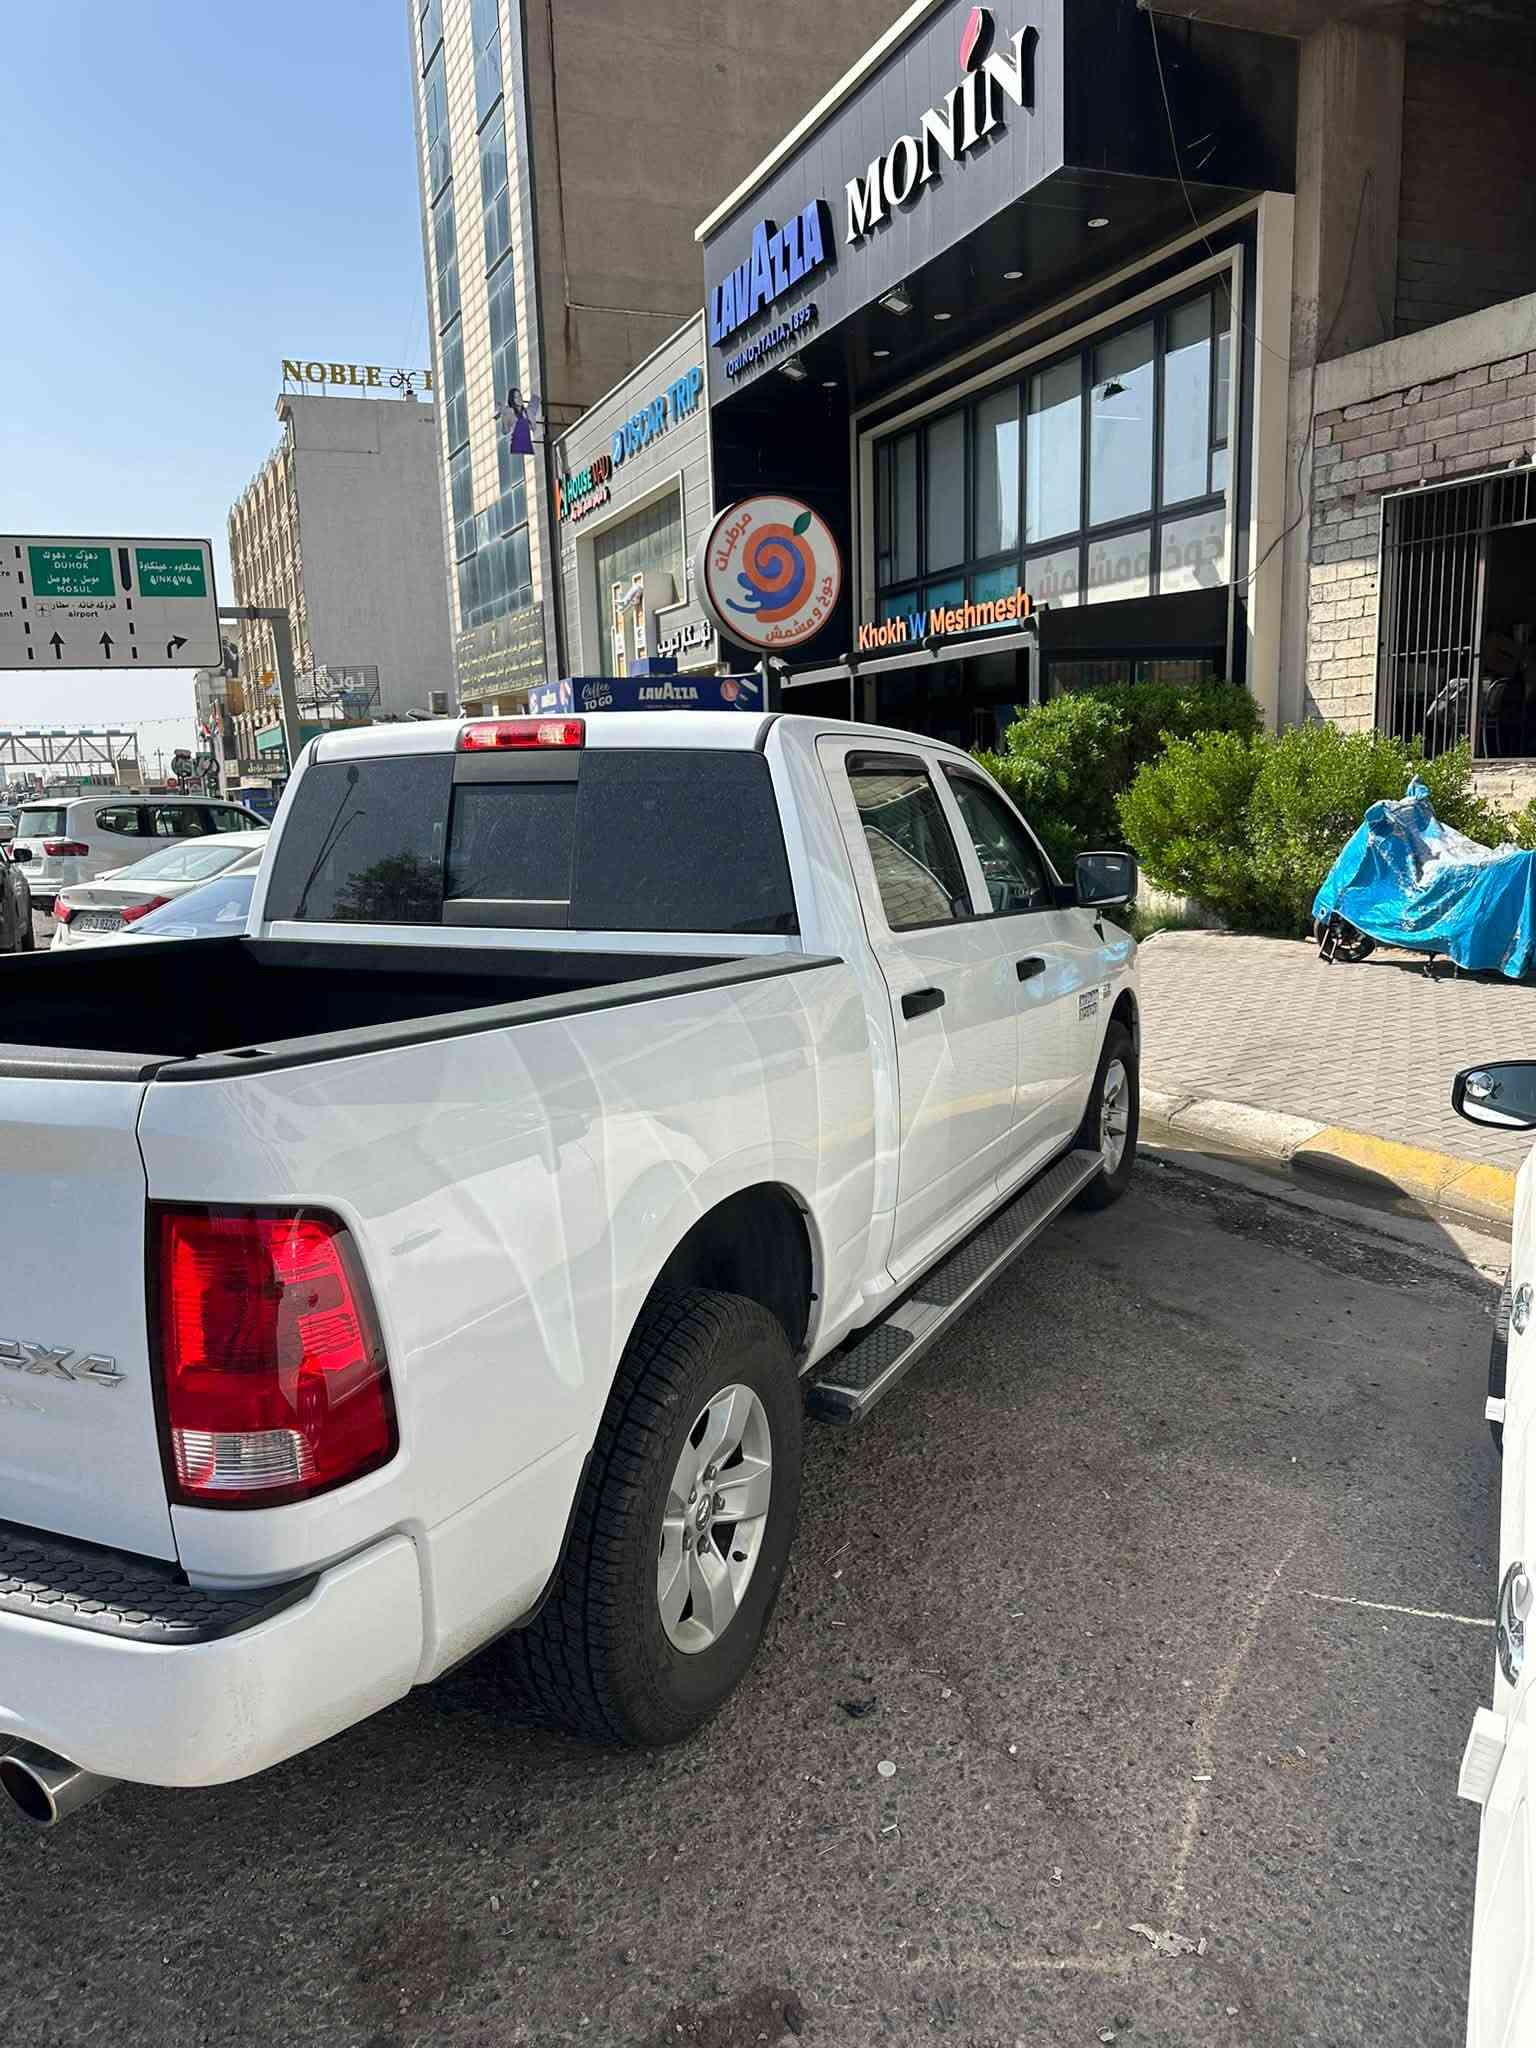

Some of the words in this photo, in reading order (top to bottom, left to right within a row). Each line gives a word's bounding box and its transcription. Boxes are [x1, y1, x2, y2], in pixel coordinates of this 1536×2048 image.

[845, 24, 1040, 244] MONIN
[282, 360, 382, 387] NOBLE
[666, 366, 703, 421] TRIP
[54, 561, 89, 569] DUHOK
[57, 585, 92, 593] MOSUL
[816, 576, 833, 607] خوخ
[68, 610, 99, 618] airport
[858, 616, 907, 650] Khokh
[908, 611, 927, 640] W
[930, 586, 1030, 636] Meshmesh
[765, 619, 815, 642] مشمش
[584, 699, 597, 711] TO
[598, 694, 613, 706] GO
[638, 682, 699, 701] LAVAZZA
